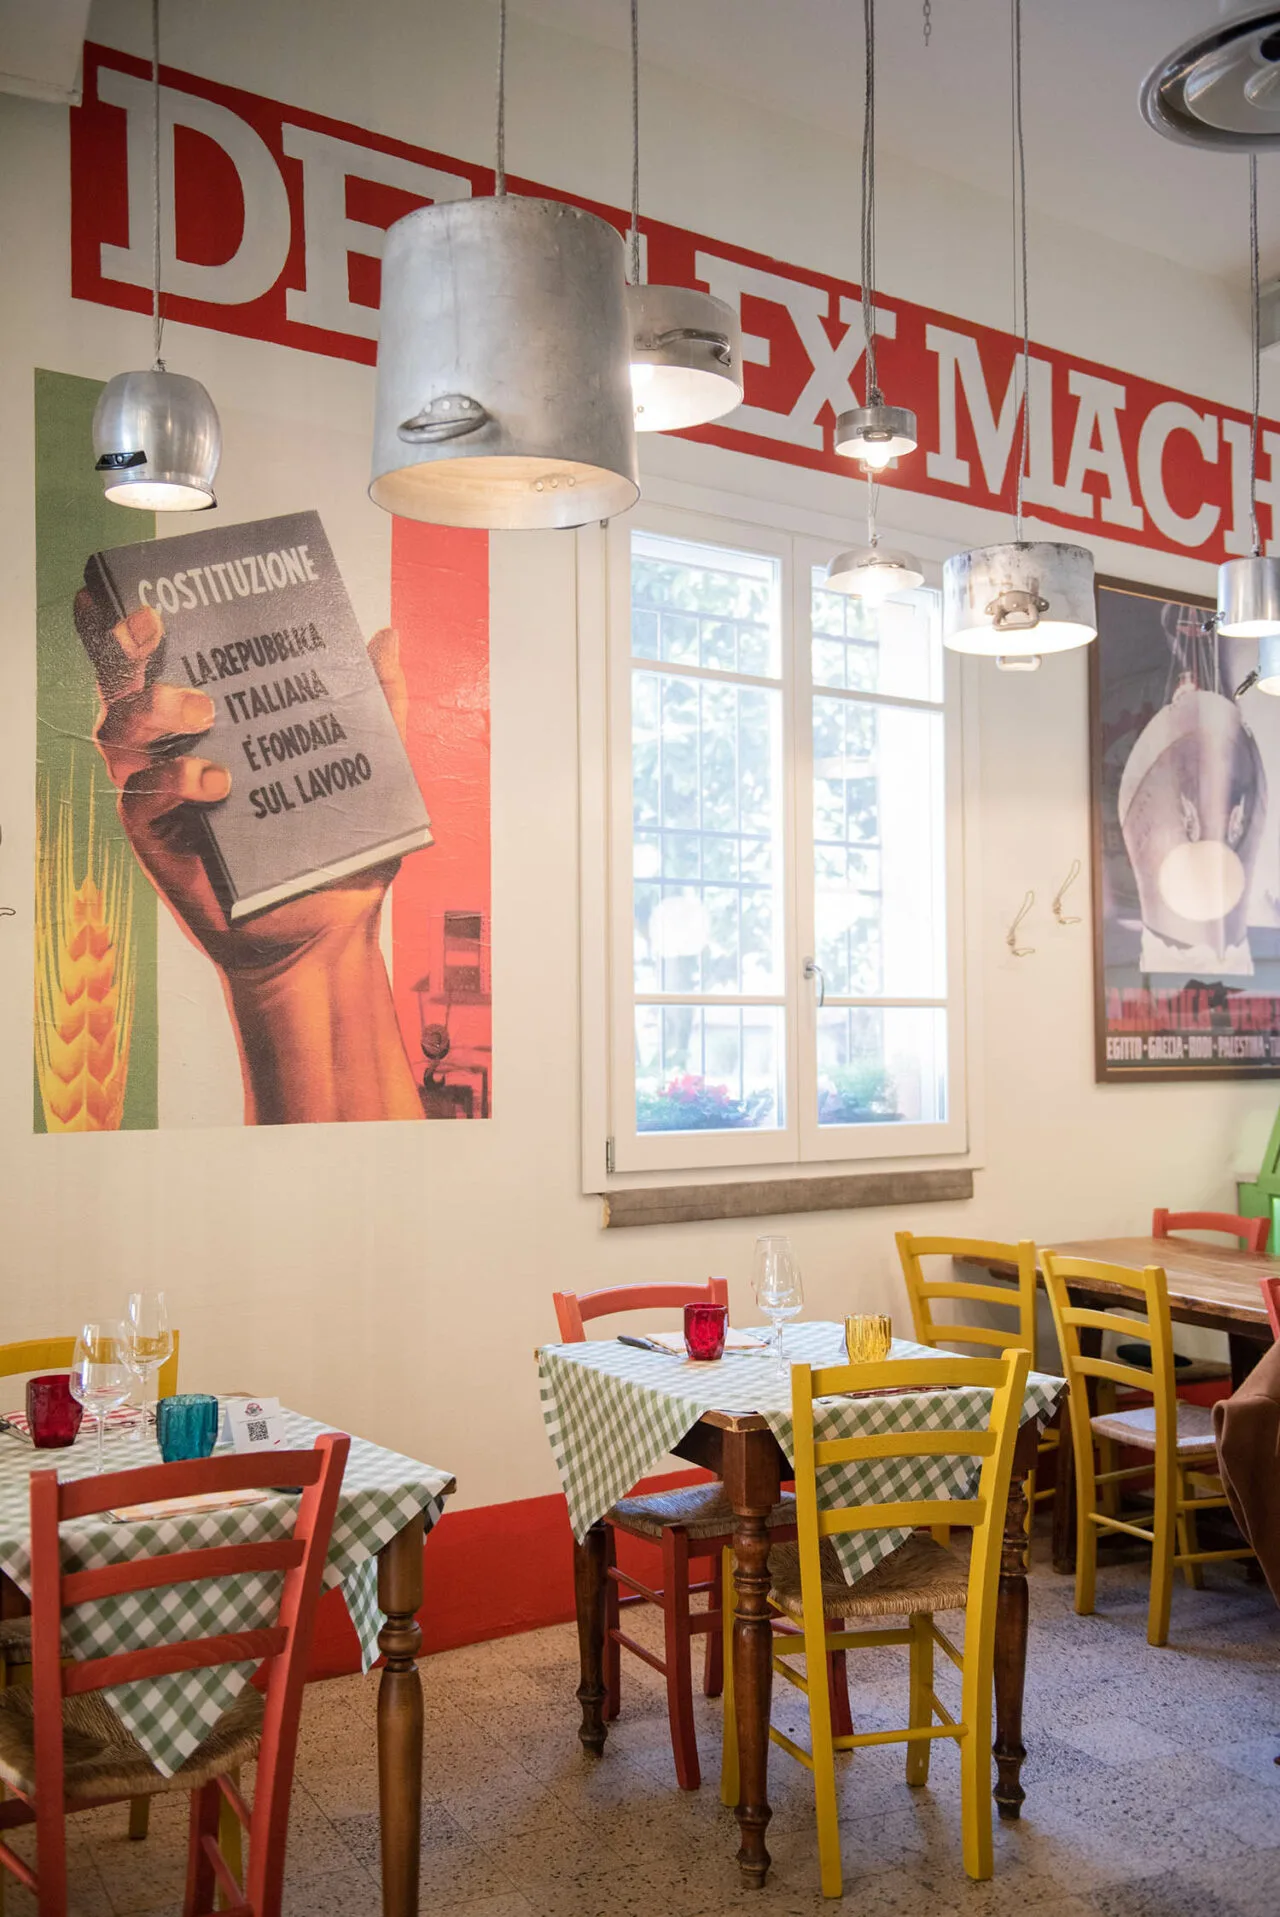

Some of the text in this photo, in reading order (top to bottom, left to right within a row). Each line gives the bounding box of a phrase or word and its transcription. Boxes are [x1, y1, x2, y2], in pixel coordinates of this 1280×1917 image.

[695, 250, 897, 468] EX
[138, 545, 320, 615] COSTITUZIONE
[180, 622, 326, 688] LA REPUBBLICA
[224, 669, 329, 724] ITALIANA
[257, 712, 347, 767] FONDATA
[249, 752, 372, 819] SUL LAVORO
